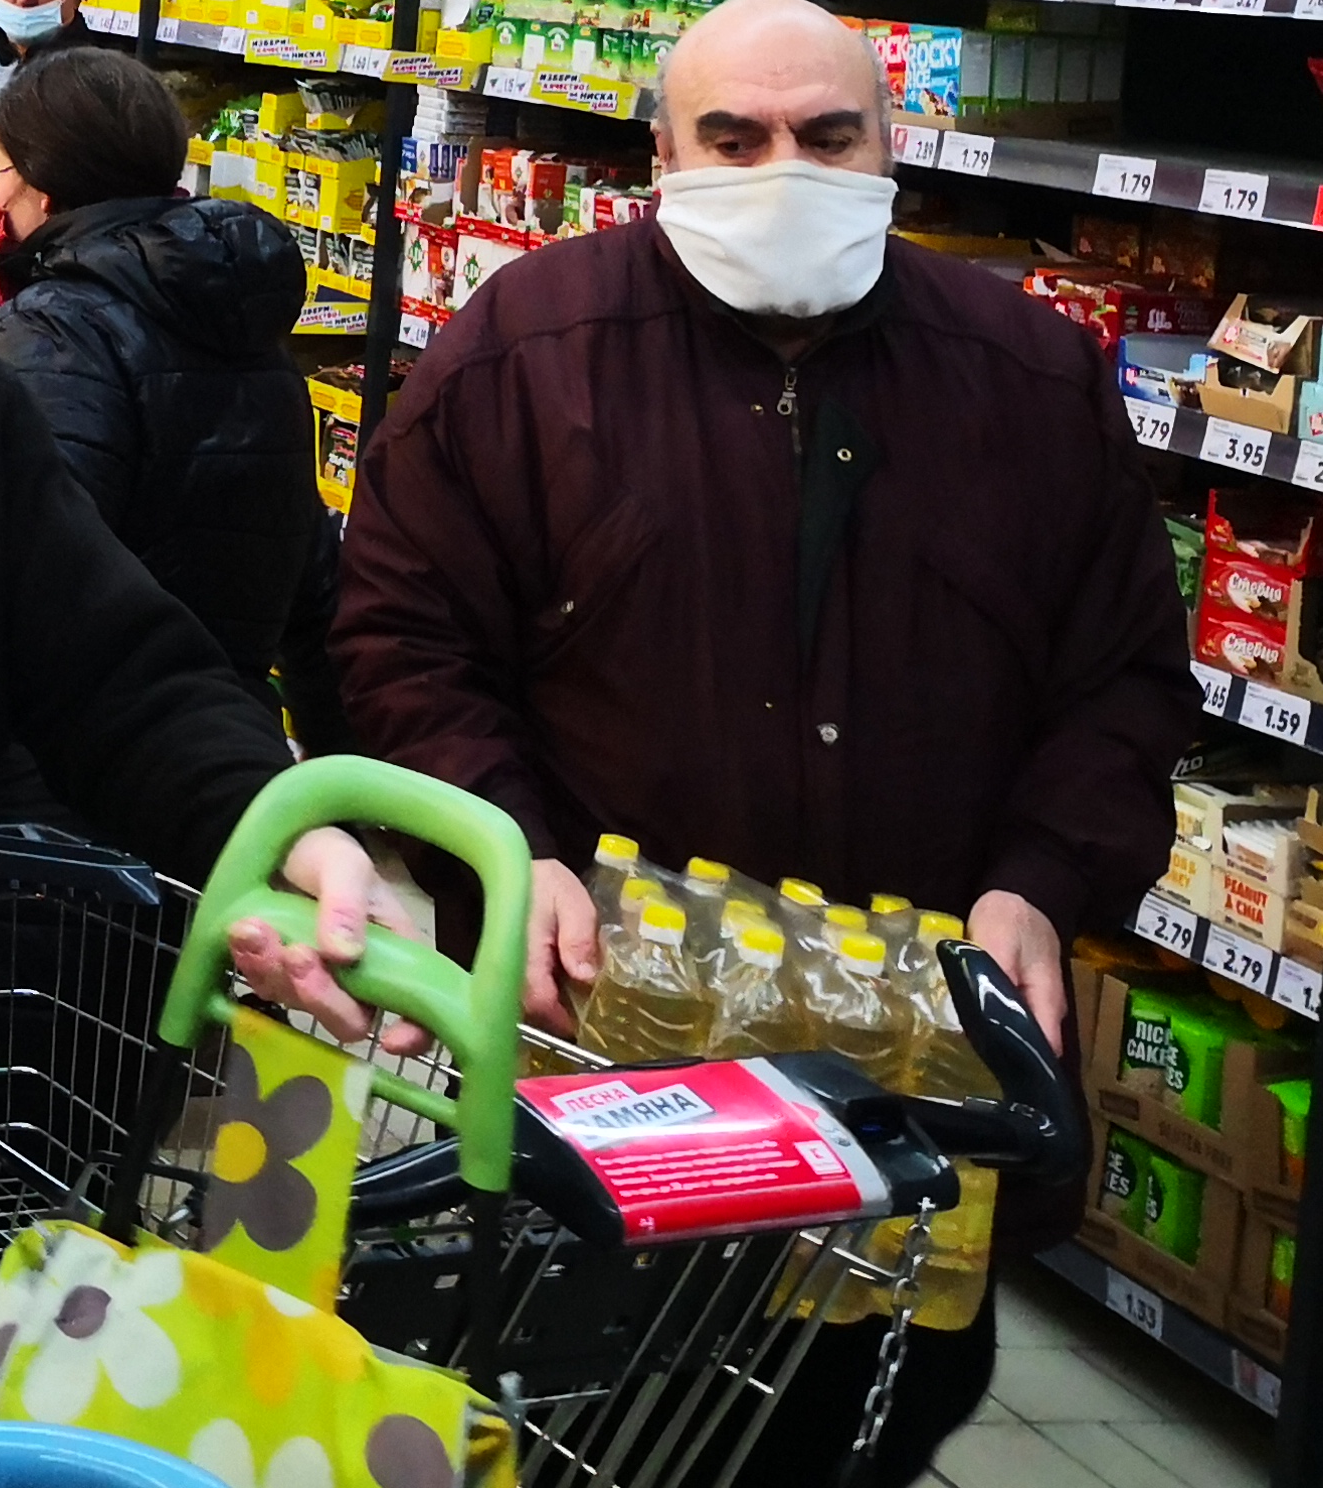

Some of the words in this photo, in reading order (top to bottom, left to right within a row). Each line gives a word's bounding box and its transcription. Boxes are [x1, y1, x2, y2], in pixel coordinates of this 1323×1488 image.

[907, 36, 962, 68] ROCKY
[962, 147, 989, 171] 1.79
[1119, 170, 1151, 198] 1.79
[1223, 188, 1259, 212] 1.79
[1135, 415, 1171, 443] 3.79
[1225, 438, 1266, 468] 3.95
[1263, 705, 1301, 737] 1.59
[1223, 873, 1269, 908] PEANUT
[1153, 916, 1193, 950] 2.79
[1223, 948, 1264, 984] 2.79
[565, 1088, 631, 1113] ЛЕСНА
